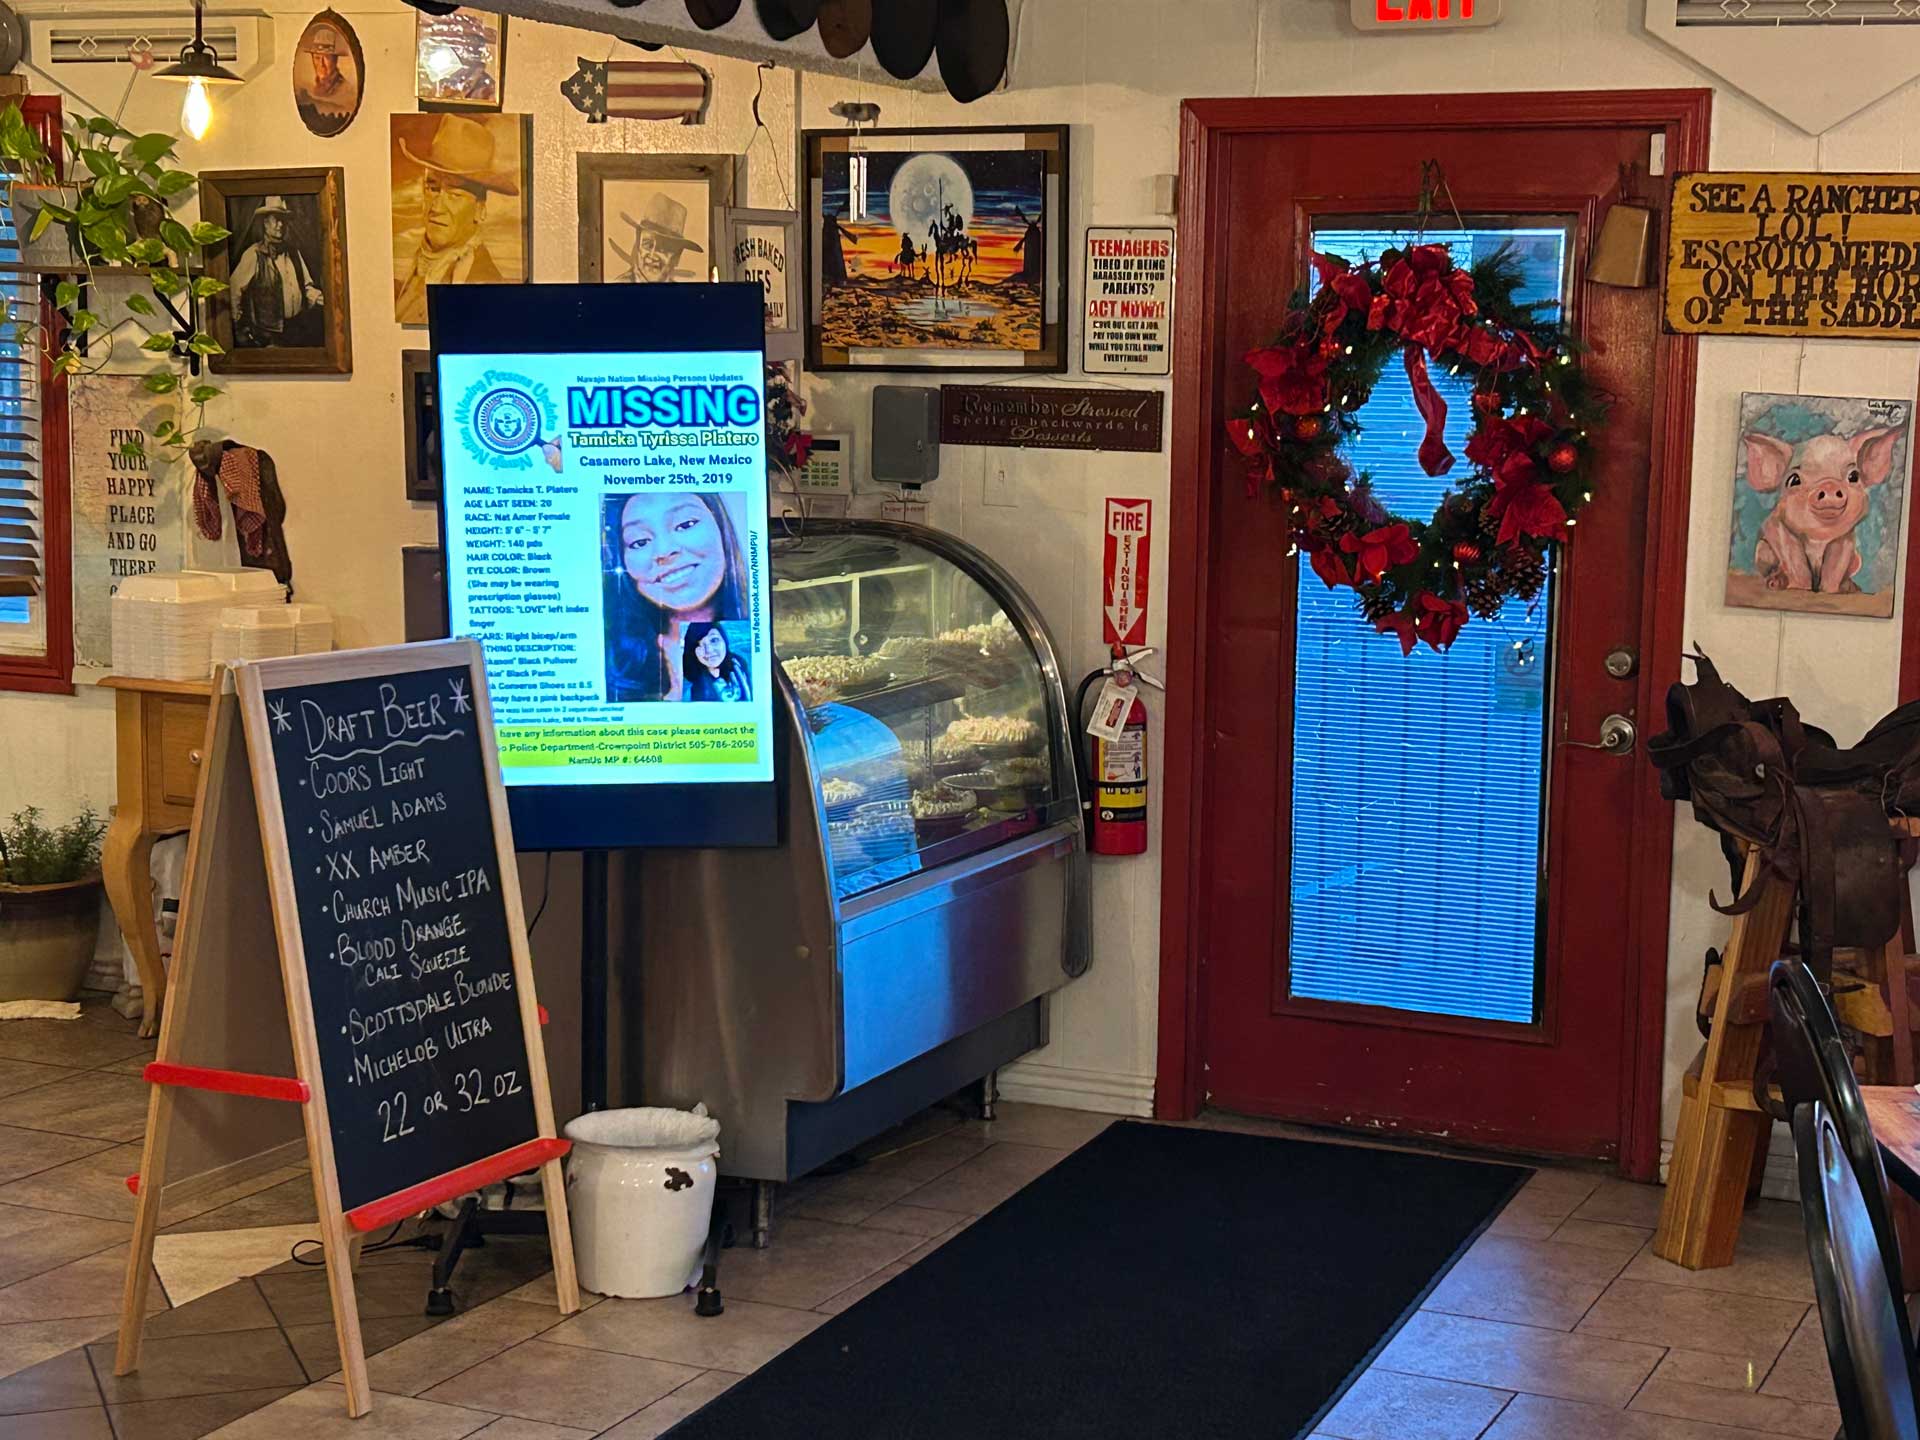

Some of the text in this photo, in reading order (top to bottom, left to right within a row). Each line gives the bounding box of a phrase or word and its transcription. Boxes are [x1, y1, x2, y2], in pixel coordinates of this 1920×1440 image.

[1690, 183, 1920, 215] SEE A RANCHER
[735, 237, 784, 273] RESH BAKED
[1089, 239, 1169, 257] TEENAGERS
[1680, 239, 1822, 273] ESCROTO
[1093, 258, 1165, 270] TIRED OF BEING
[1093, 271, 1165, 281] HARASSED BY YOUR
[1703, 267, 1757, 299] ON
[1767, 268, 1839, 301] THE
[1102, 282, 1155, 295] PARENTS?
[1089, 300, 1118, 318] ACT
[1684, 296, 1731, 325] OF
[1742, 298, 1809, 327] THE
[608, 374, 636, 383] Nation
[638, 374, 671, 383] Missing
[673, 374, 707, 382] Persons
[710, 373, 744, 382] Updates
[567, 385, 760, 428] MISSING
[1061, 397, 1148, 419] Stressed
[1029, 417, 1125, 431] backwards
[110, 429, 144, 447] FIND
[568, 429, 759, 450] Tamicka Tyrissa Platero
[1008, 425, 1094, 444] Desserts
[107, 452, 149, 471] YOUR
[579, 454, 752, 467] Casamero Lake, New Mexico
[106, 477, 156, 497] HAPPY
[604, 473, 733, 486] November 25th, 2019
[464, 486, 494, 495] NAME:
[496, 486, 534, 494] Tamicka
[546, 485, 578, 494] Platero
[464, 500, 483, 508] AGE
[485, 499, 509, 508] LAST
[109, 505, 156, 525] PLACE
[464, 513, 492, 521] RACE:
[1113, 511, 1144, 531] FIRE
[466, 526, 503, 535] HEIGHT:
[107, 532, 157, 551] AND GO
[466, 540, 524, 548] WEIGHT: 140
[467, 553, 489, 561] HAIR
[492, 553, 525, 561] COLOR:
[109, 558, 156, 577] THERE
[467, 566, 484, 575] EYE
[487, 566, 520, 574] COLOR:
[1119, 534, 1132, 631] EXTINGUISHER
[469, 606, 514, 614] TATTOOS:
[300, 683, 447, 754] DRAFT BEER
[500, 726, 755, 739] have any information about this case please contact the
[509, 743, 538, 752] Police
[653, 741, 687, 750] District
[605, 756, 620, 764] MP
[310, 756, 426, 799] COORS LIGHT
[320, 792, 448, 844] SAMUEL ADAMS
[325, 839, 431, 881] XX AMBER
[333, 867, 491, 923] CHURCH MUSIC IPA
[338, 914, 467, 967] BLOOD ORANGE
[364, 945, 471, 987] CALI SQUEEZE
[350, 970, 512, 1046] SCOTTSDALE BLONDE
[354, 1015, 493, 1087] MICHELOB ULTRA
[377, 1091, 416, 1143] 22
[423, 1090, 448, 1117] OR
[455, 1068, 490, 1112] 32
